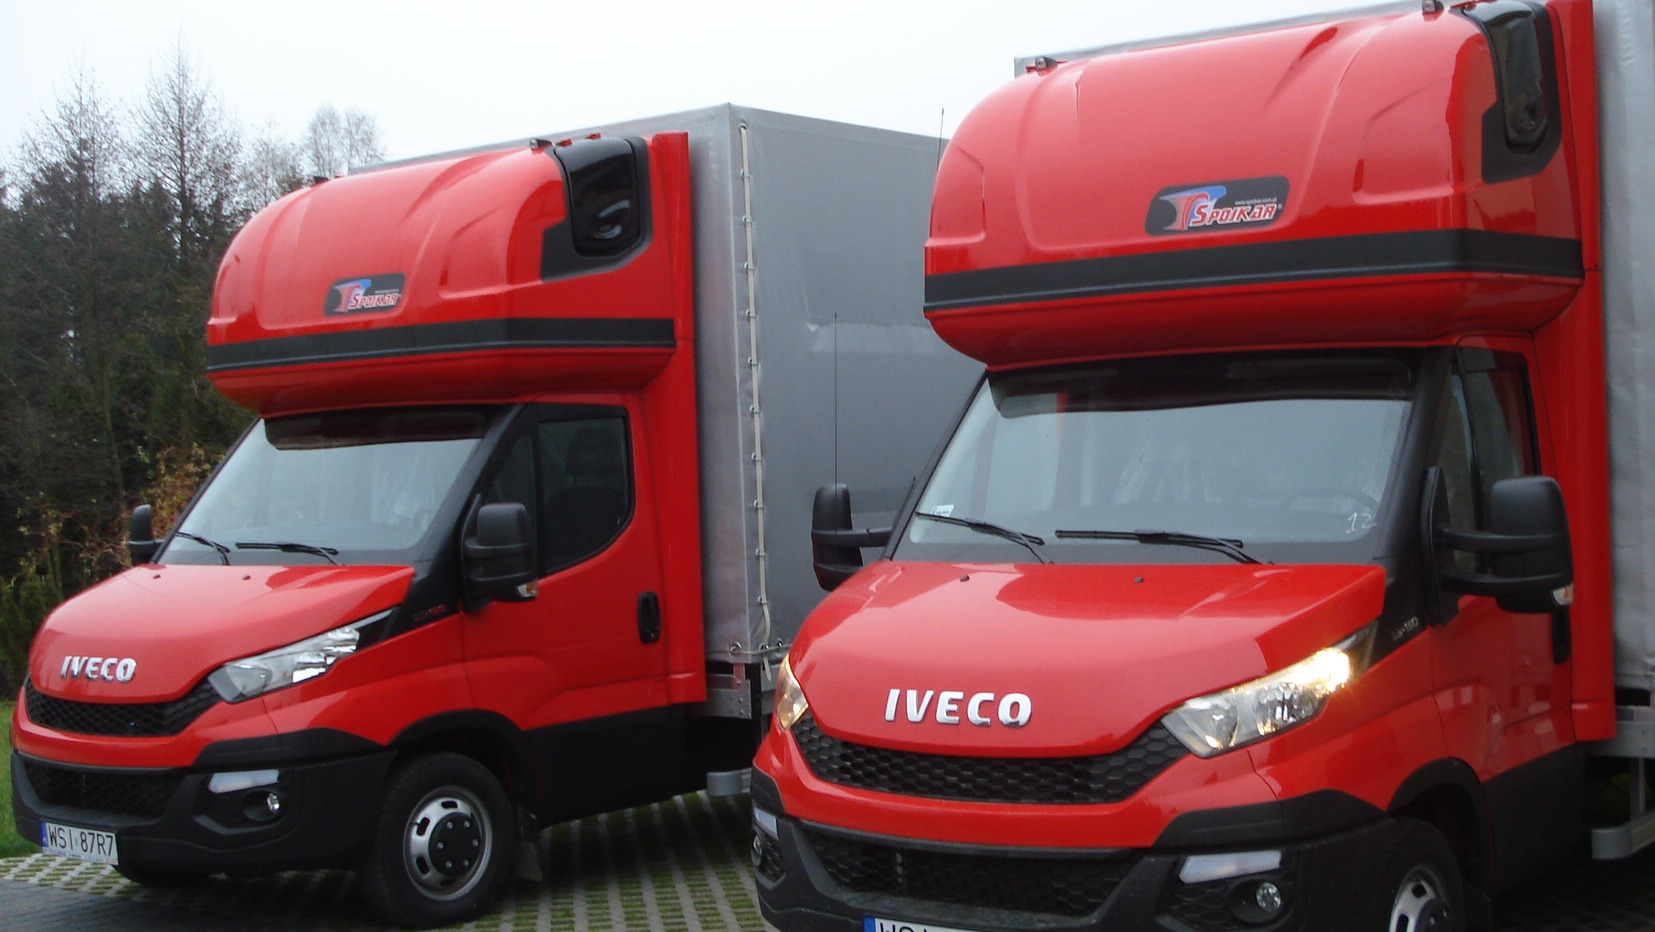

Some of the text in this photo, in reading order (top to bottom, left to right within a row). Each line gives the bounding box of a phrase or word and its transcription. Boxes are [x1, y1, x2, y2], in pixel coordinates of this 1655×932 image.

[60, 655, 137, 682] IVECO
[884, 688, 1033, 728] IVECO
[48, 825, 74, 850] WSI
[80, 831, 113, 856] 87R7
